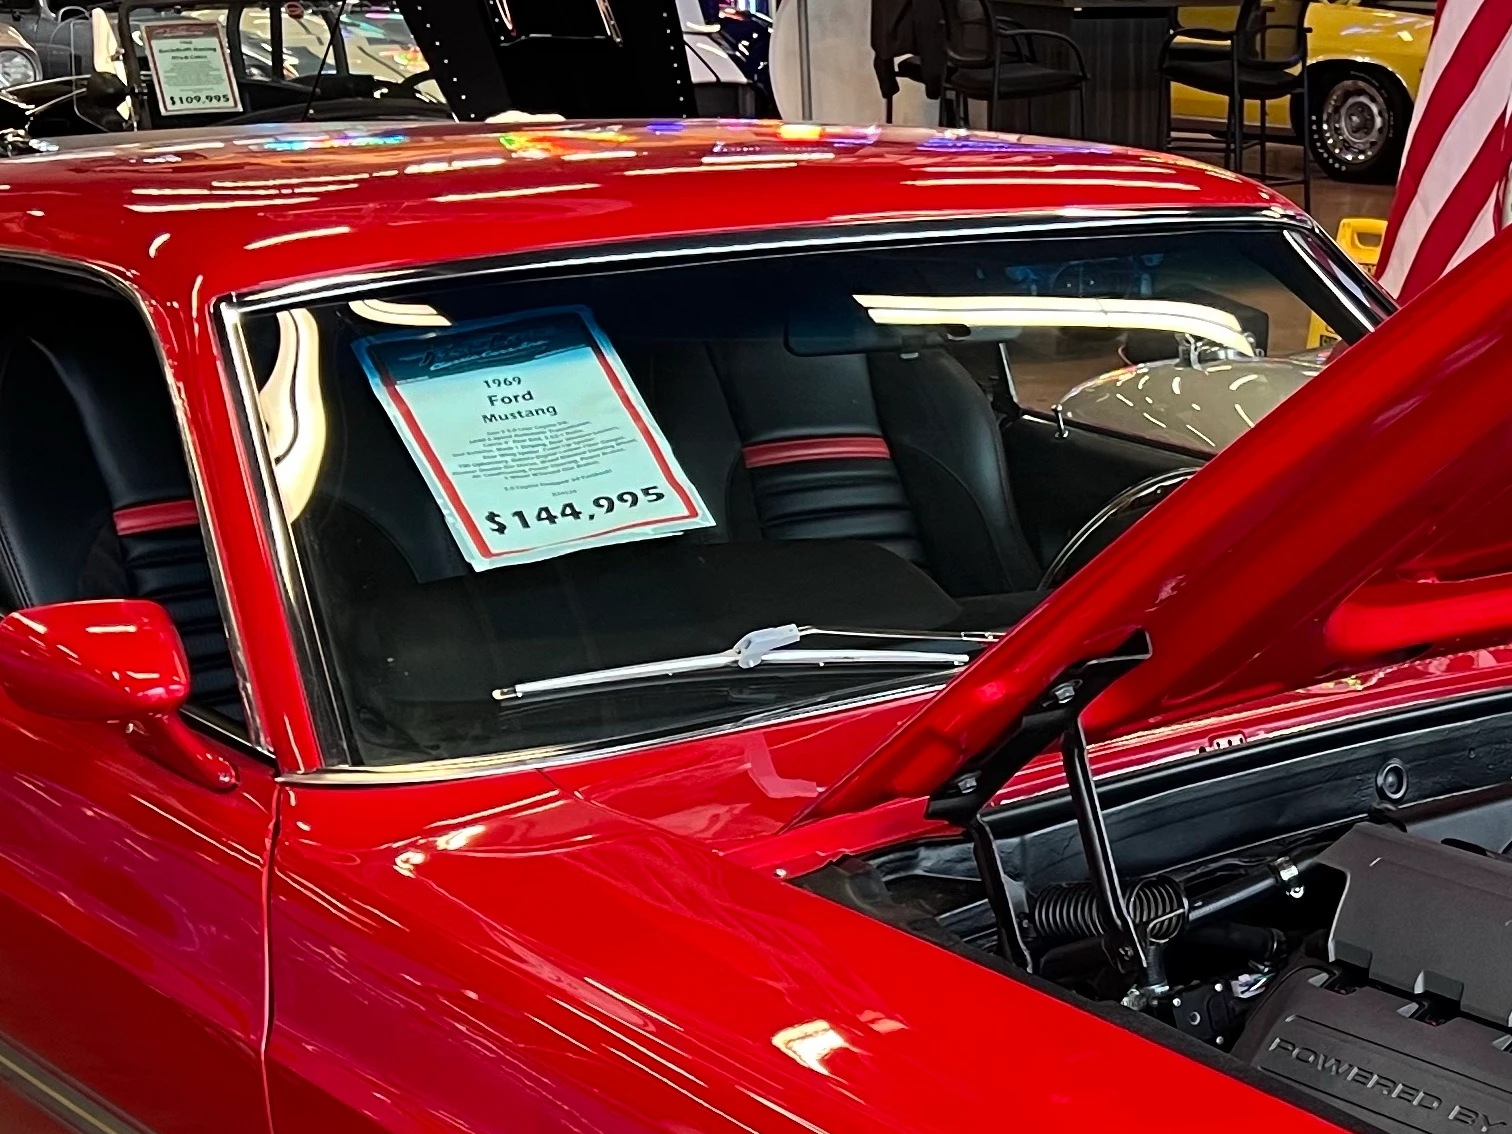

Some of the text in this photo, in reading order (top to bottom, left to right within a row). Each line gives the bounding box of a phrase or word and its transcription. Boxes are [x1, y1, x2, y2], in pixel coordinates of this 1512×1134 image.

[169, 94, 229, 105] $109,995
[483, 376, 522, 388] 1969
[487, 390, 534, 406] Ford
[481, 404, 558, 424] Mustang
[485, 485, 664, 535] $144,995
[1269, 1037, 1443, 1110] POWERED
[1448, 1104, 1507, 1132] BY
